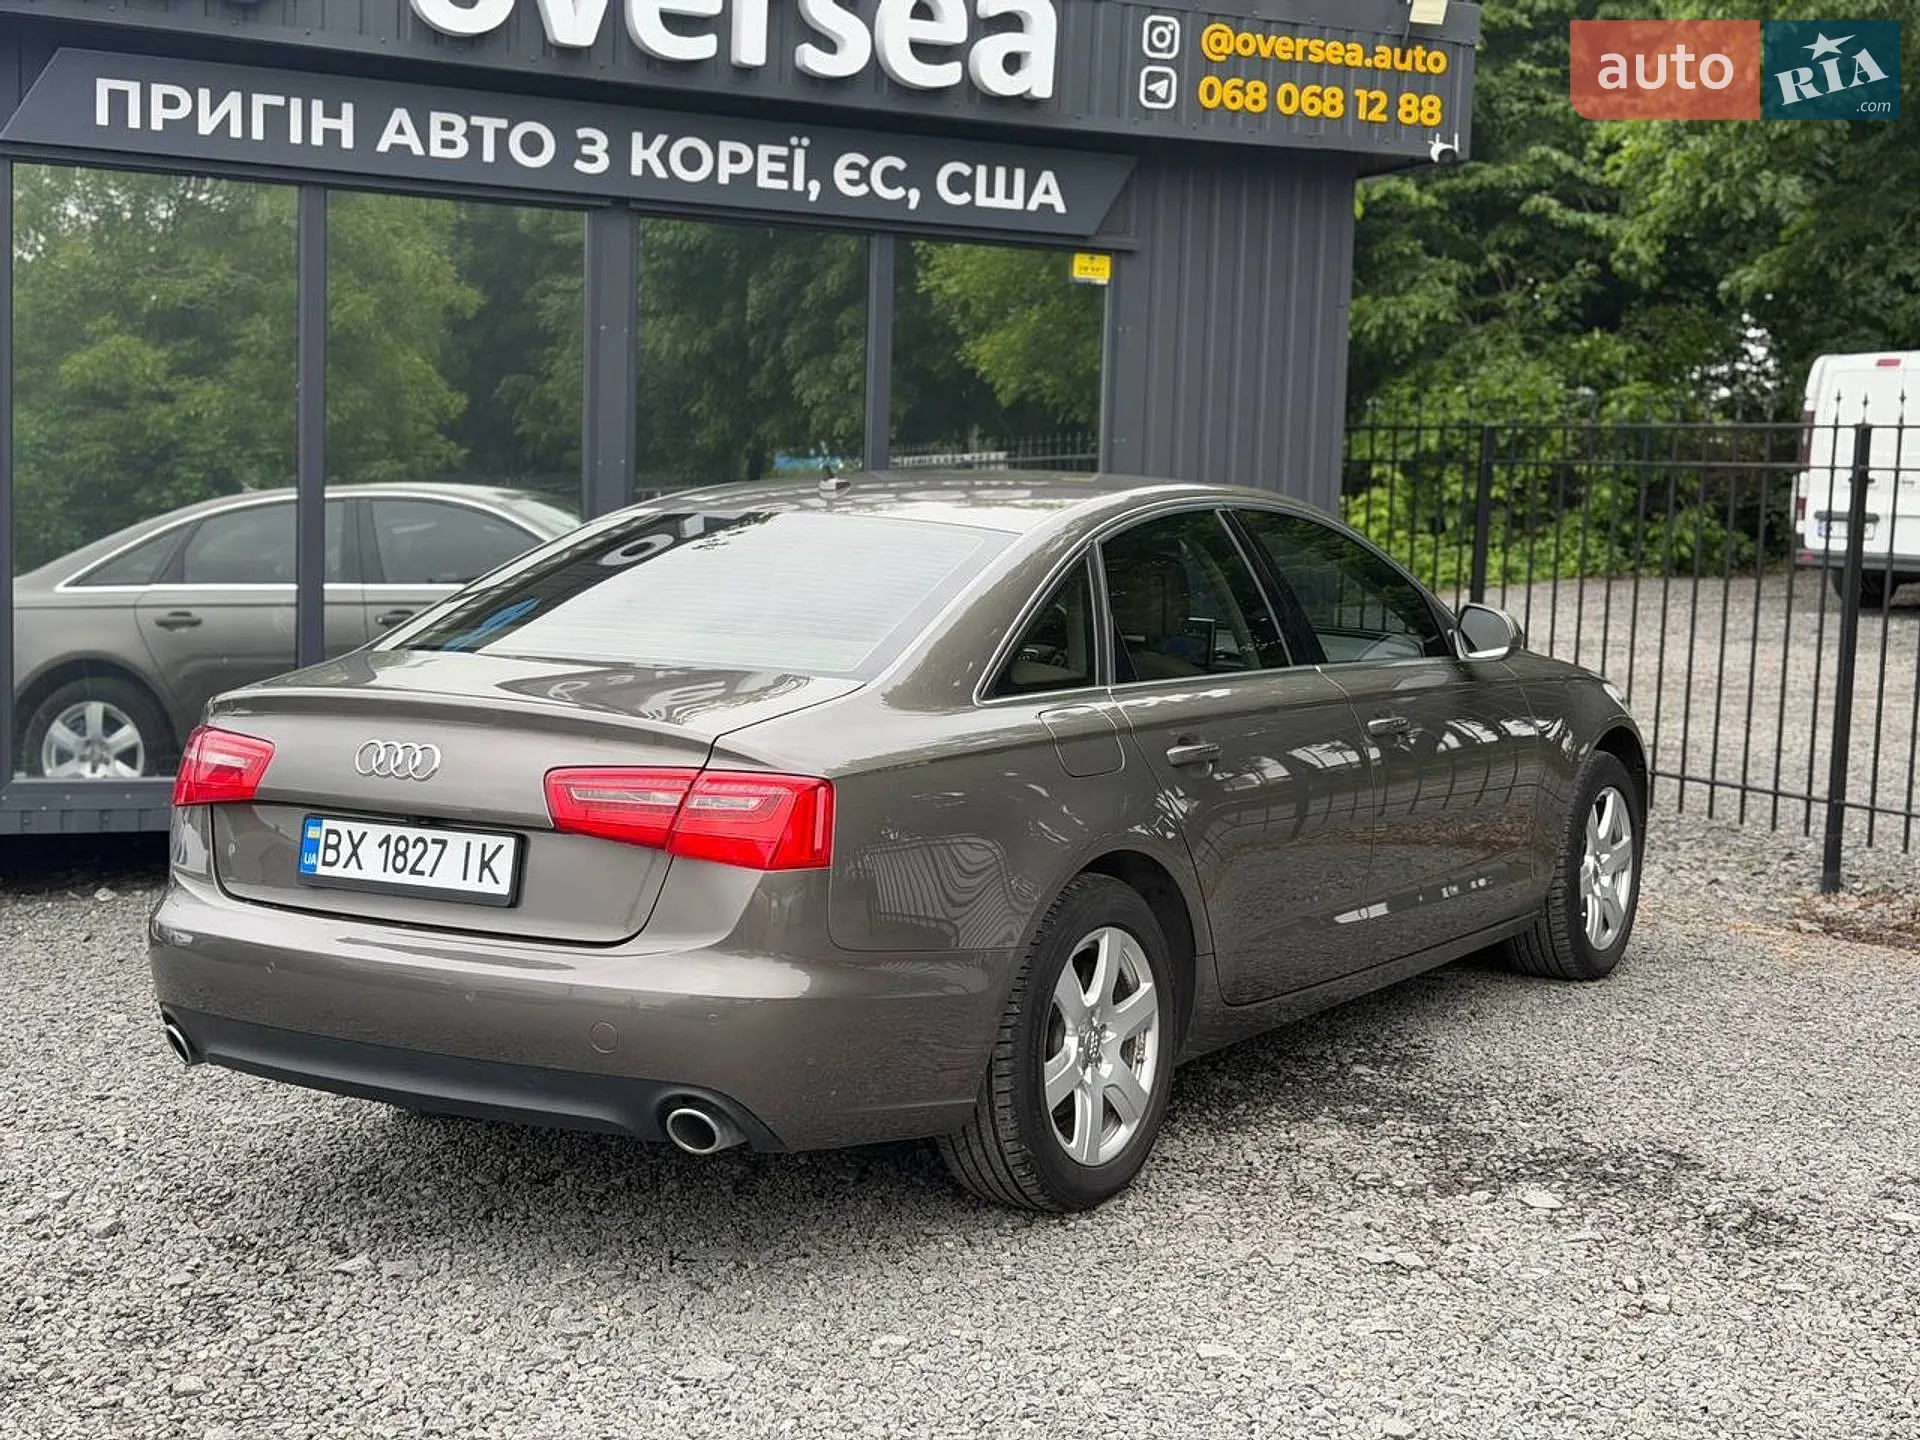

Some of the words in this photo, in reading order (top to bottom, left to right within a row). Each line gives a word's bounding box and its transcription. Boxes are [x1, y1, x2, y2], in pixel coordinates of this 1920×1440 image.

[1200, 22, 1449, 75] @oversea.auto
[1198, 75, 1269, 114] 068
[1275, 82, 1346, 120] 068
[1354, 88, 1389, 123] 12
[1397, 92, 1443, 127] 88
[95, 77, 354, 150] ПРИГІН
[375, 107, 556, 169] АВТО
[573, 127, 610, 175] З
[630, 131, 821, 202] КОРЕЇ,
[833, 152, 921, 210] ЄС,
[935, 161, 1067, 214] США
[321, 828, 368, 871] BX
[377, 833, 448, 878] 1827
[462, 841, 505, 885] IK
